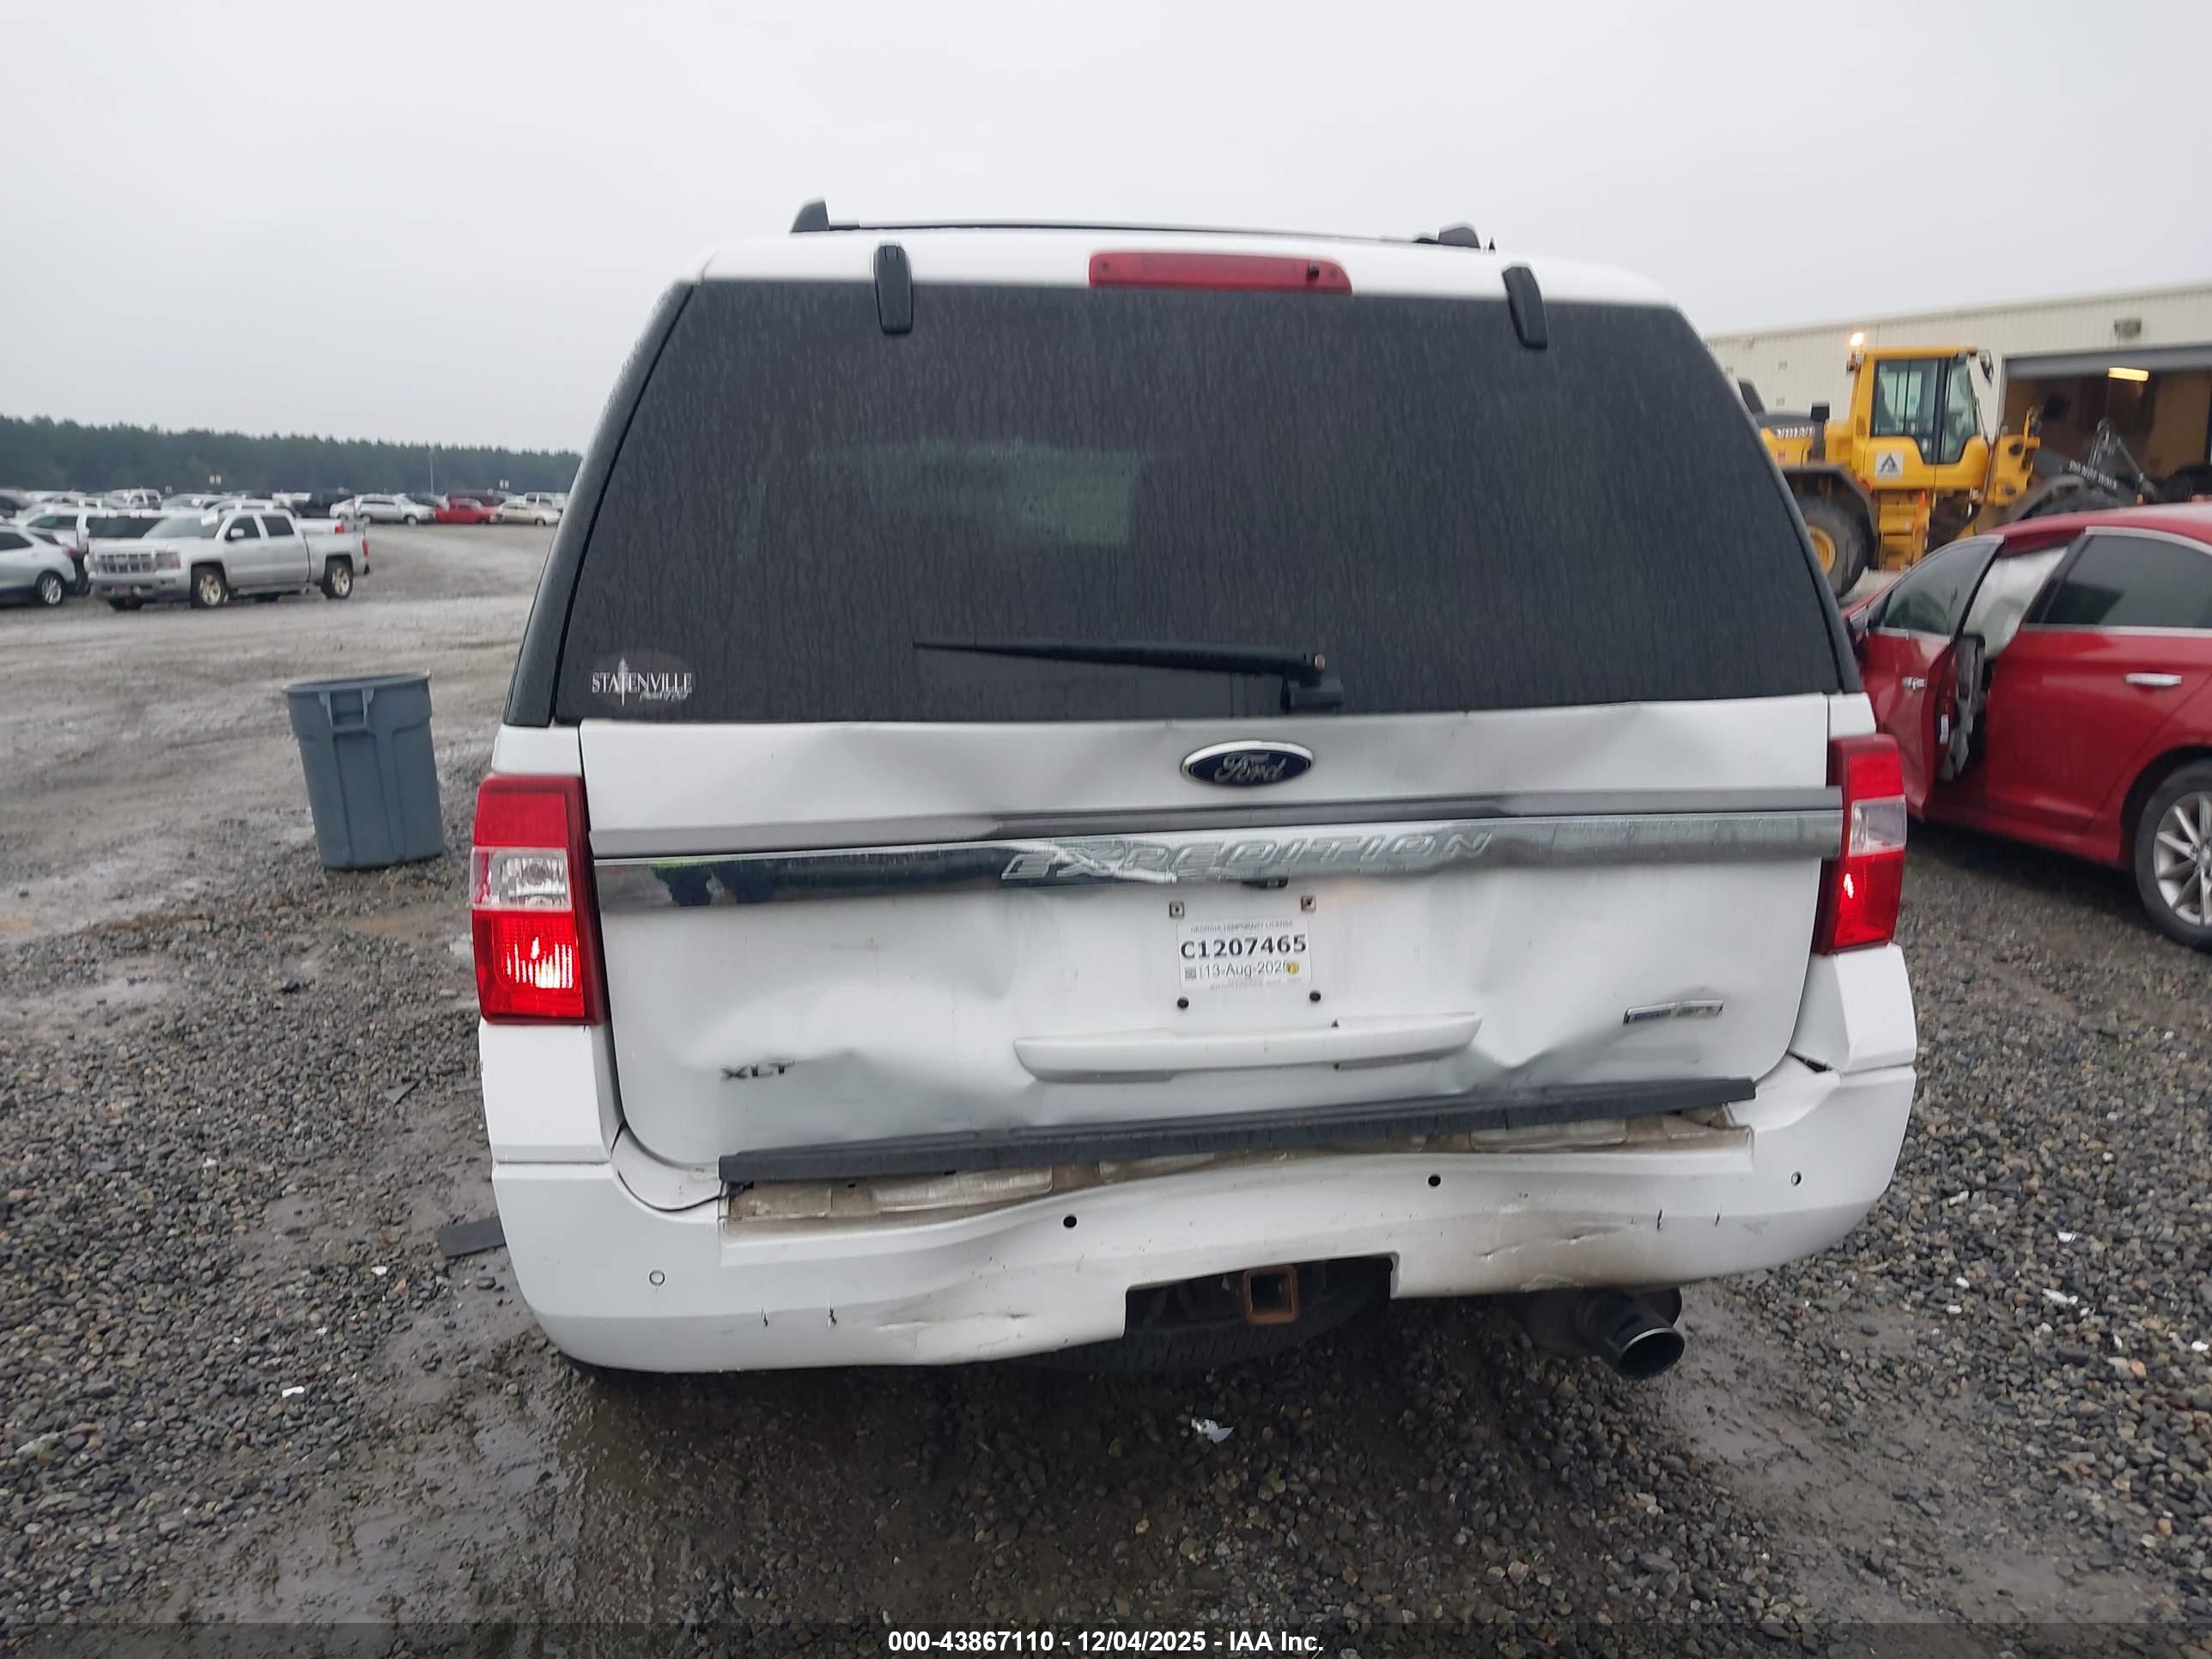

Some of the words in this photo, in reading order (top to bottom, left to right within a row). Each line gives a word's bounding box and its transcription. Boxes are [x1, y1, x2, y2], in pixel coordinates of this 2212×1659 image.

[1214, 752, 1286, 783] Ford
[1181, 934, 1306, 959] C1207465
[722, 1058, 795, 1082] XLT
